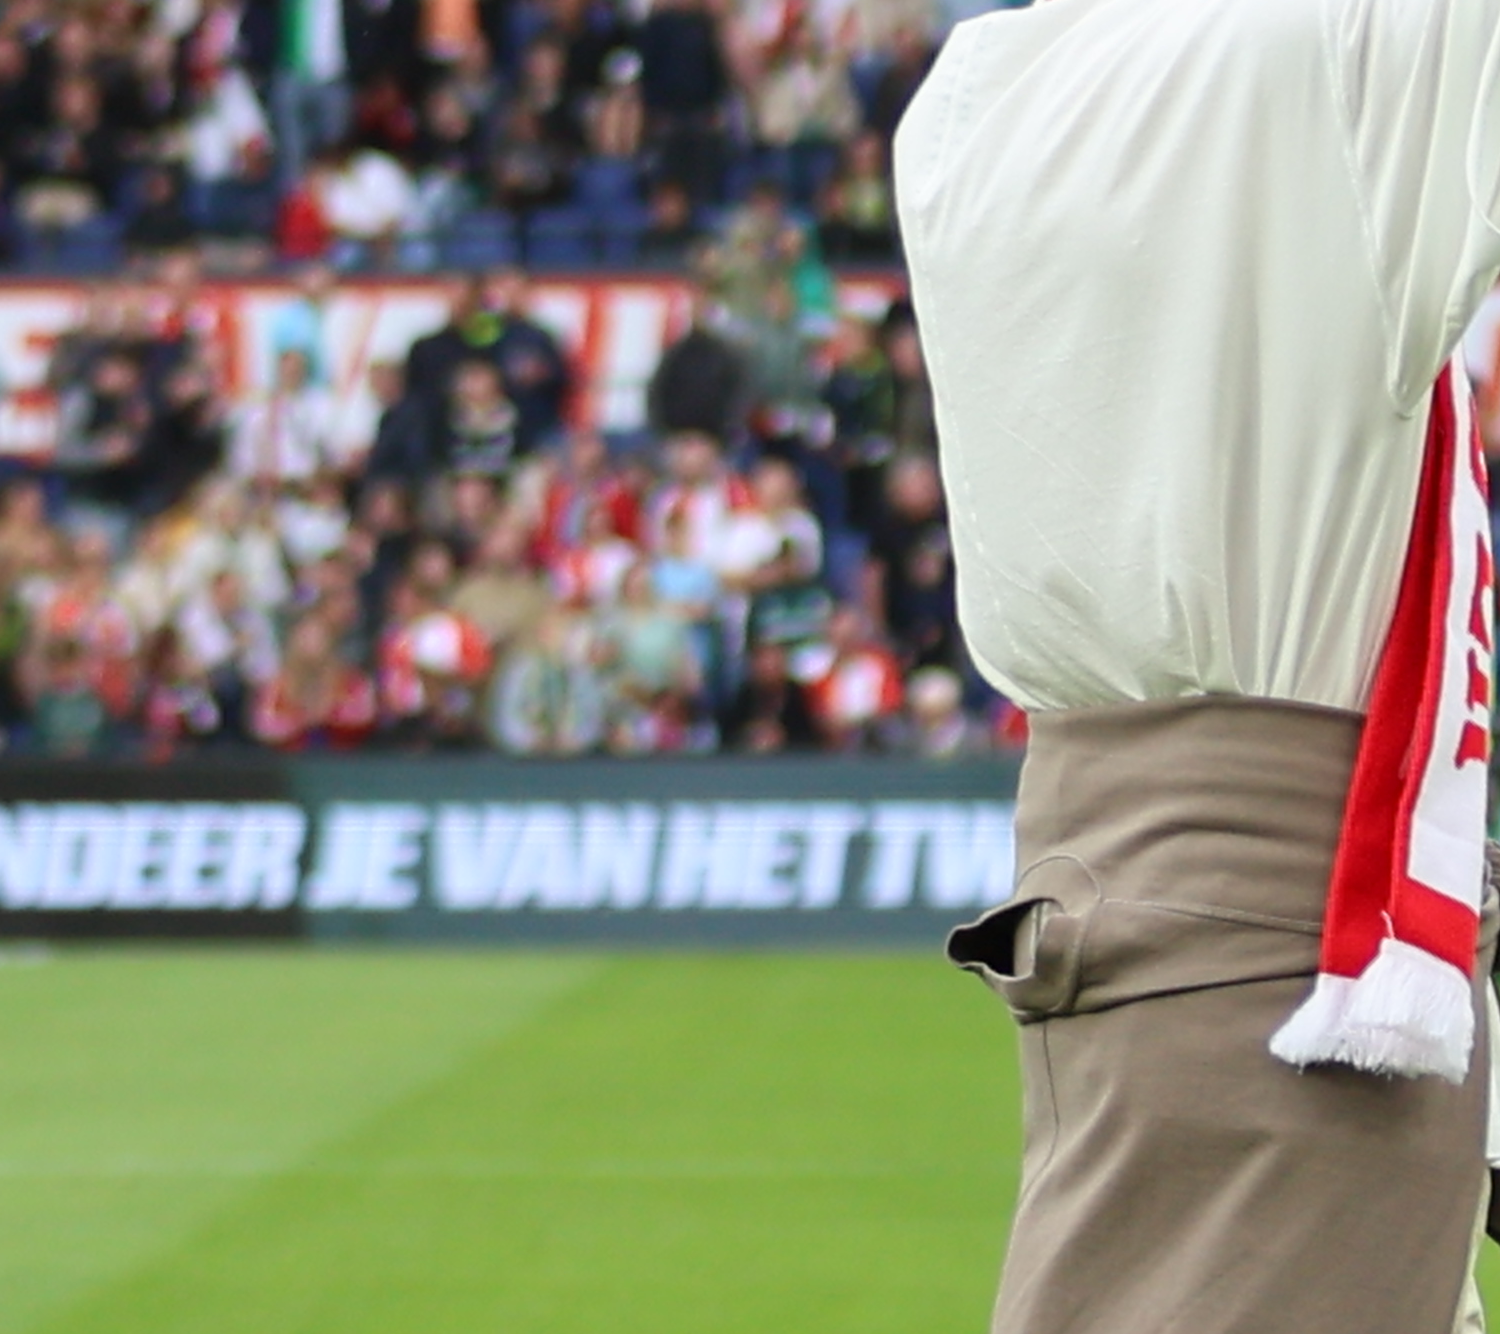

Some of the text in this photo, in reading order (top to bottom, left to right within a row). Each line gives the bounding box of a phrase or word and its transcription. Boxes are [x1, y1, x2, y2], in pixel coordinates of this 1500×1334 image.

[303, 800, 431, 911] JE
[432, 800, 657, 911] VAN
[659, 800, 858, 911] HET
